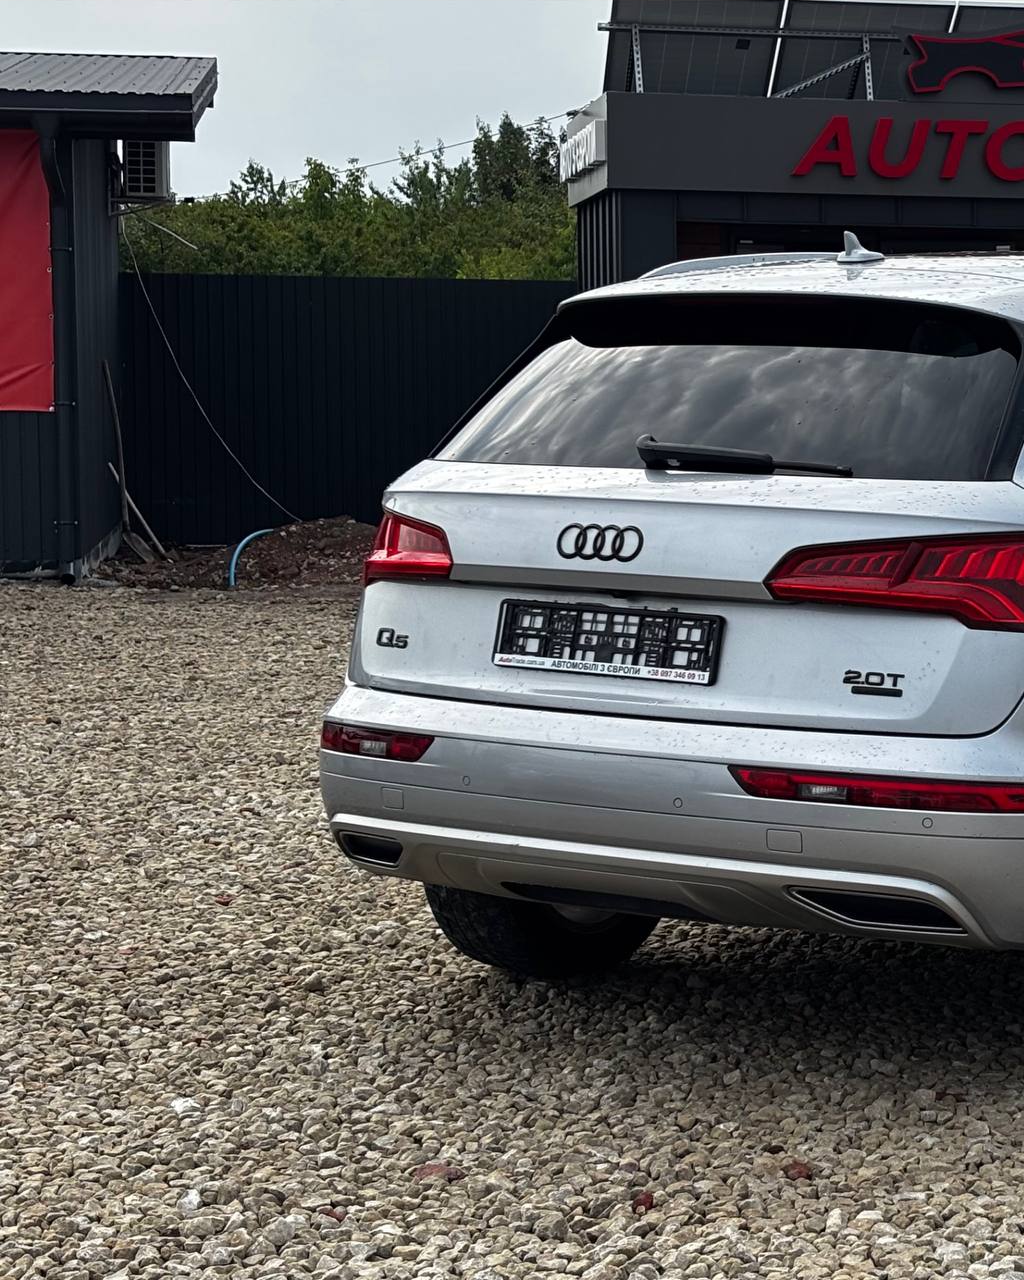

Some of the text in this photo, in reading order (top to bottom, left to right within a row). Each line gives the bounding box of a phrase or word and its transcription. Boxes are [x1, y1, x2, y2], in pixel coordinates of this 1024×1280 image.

[376, 627, 409, 649] Q5
[551, 660, 599, 672] АВТОМОБІЛІ
[607, 665, 640, 676] ЄВРОПИ
[843, 669, 905, 687] 2.0T
